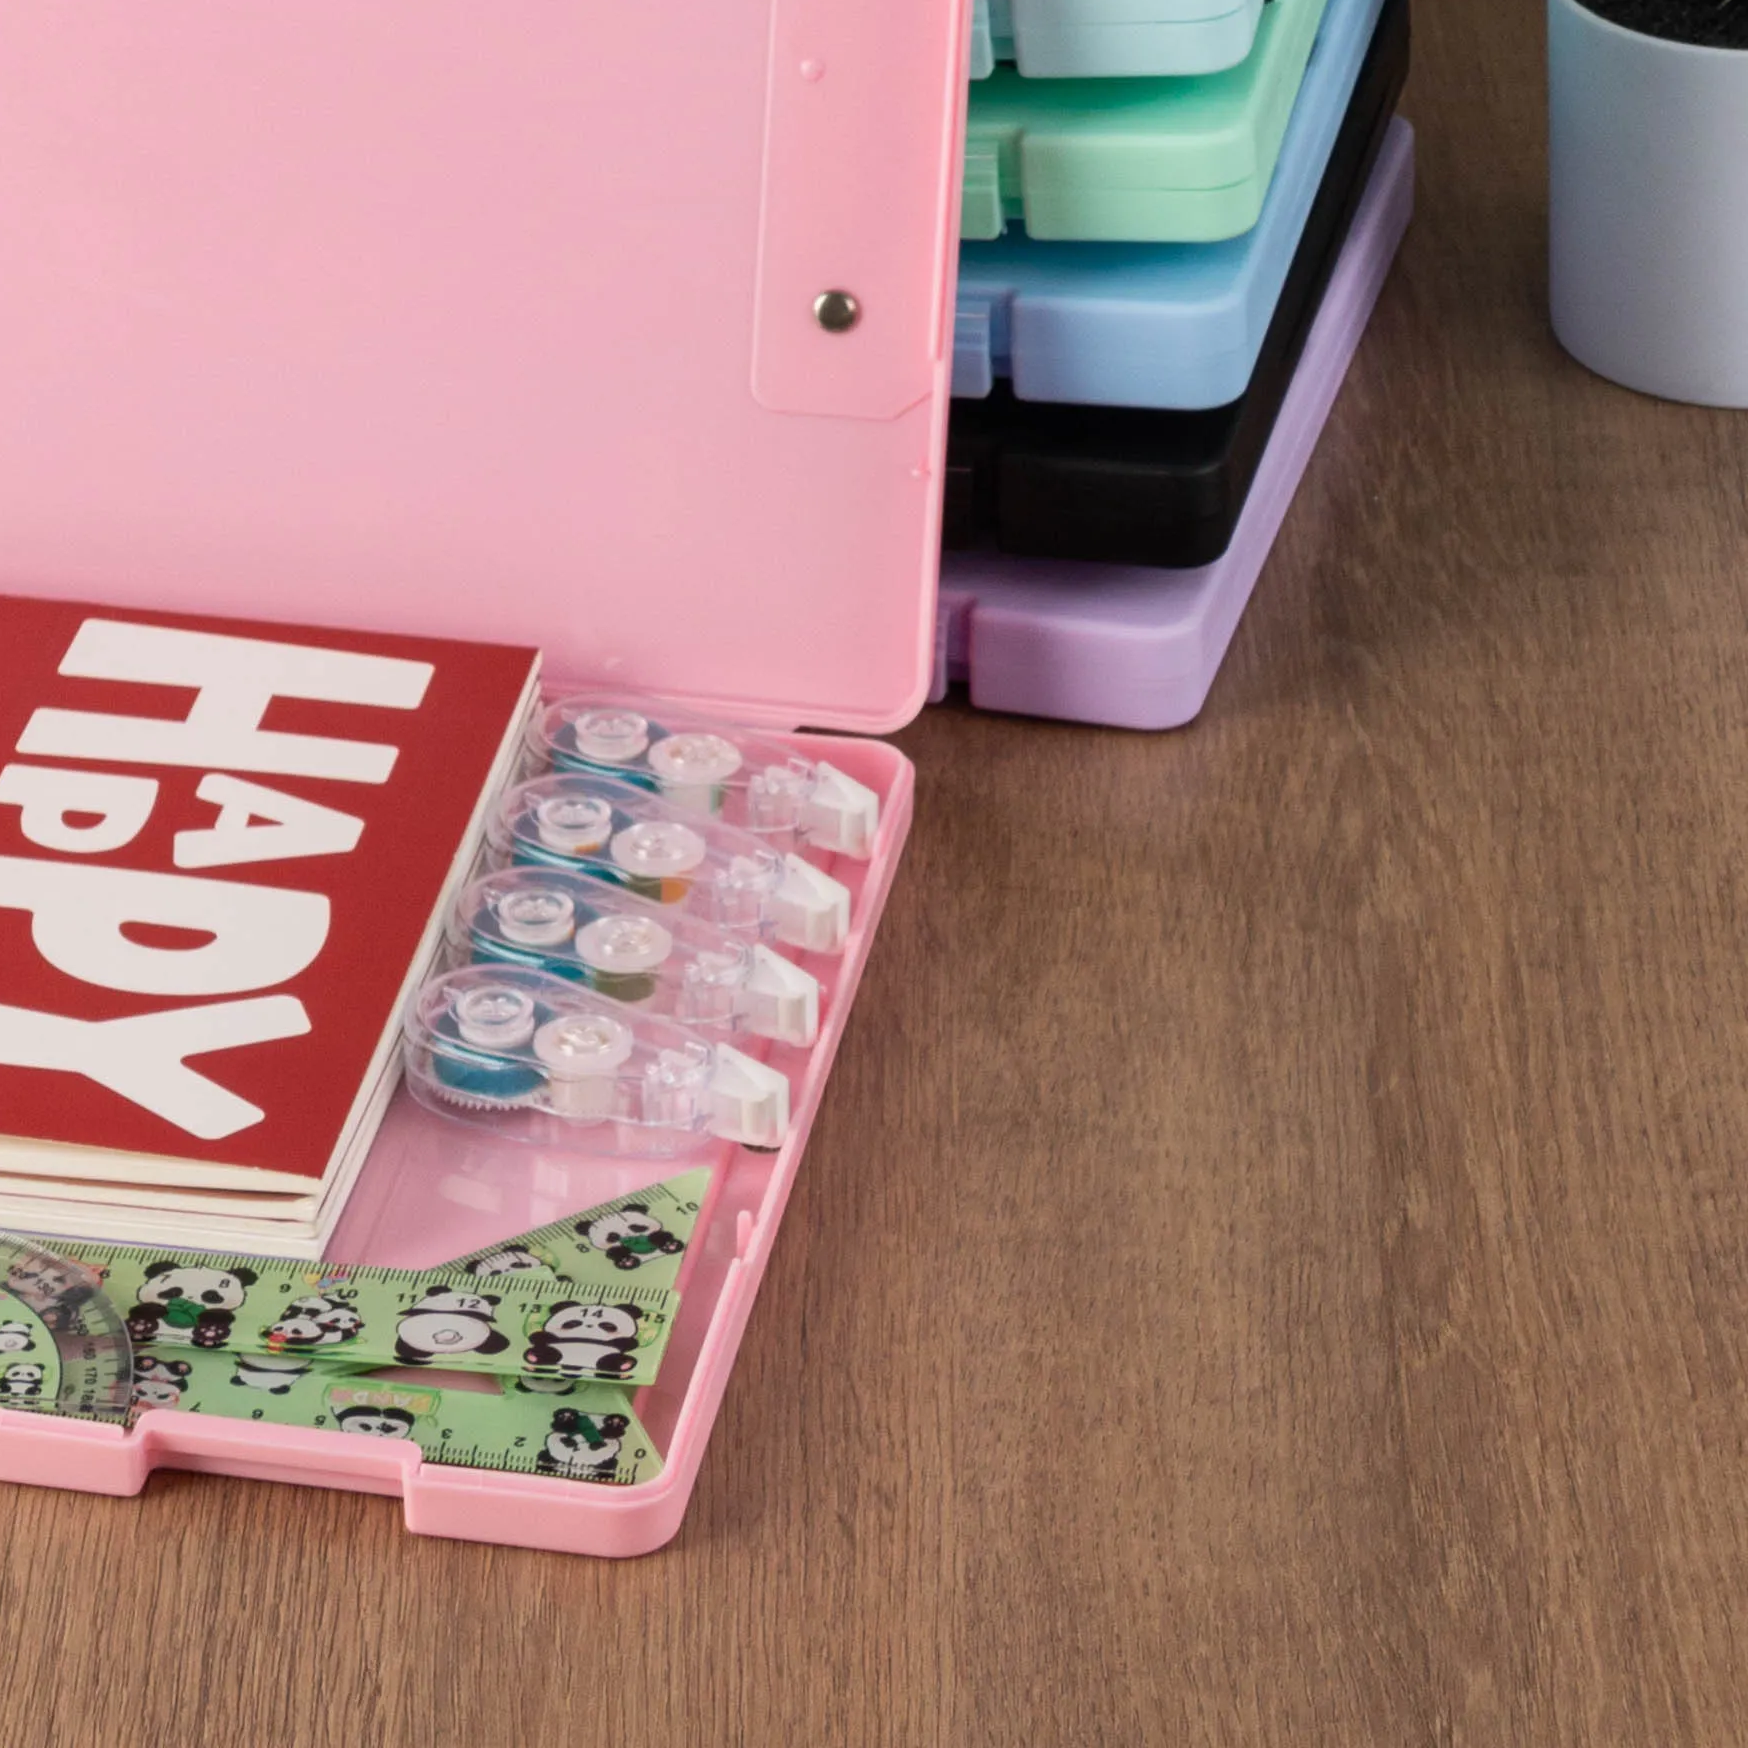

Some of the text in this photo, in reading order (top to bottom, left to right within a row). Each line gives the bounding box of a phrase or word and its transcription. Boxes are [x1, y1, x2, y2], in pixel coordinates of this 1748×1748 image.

[676, 1201, 699, 1217] 10
[160, 1273, 172, 1284] 7
[218, 1278, 231, 1289] 8
[279, 1283, 292, 1294] 9
[335, 1287, 359, 1299] 10
[396, 1293, 417, 1305] 11
[456, 1297, 482, 1309] 12
[518, 1302, 541, 1314] 13
[580, 1307, 604, 1319] 14
[642, 1312, 667, 1325] 15
[84, 1366, 98, 1385] 170
